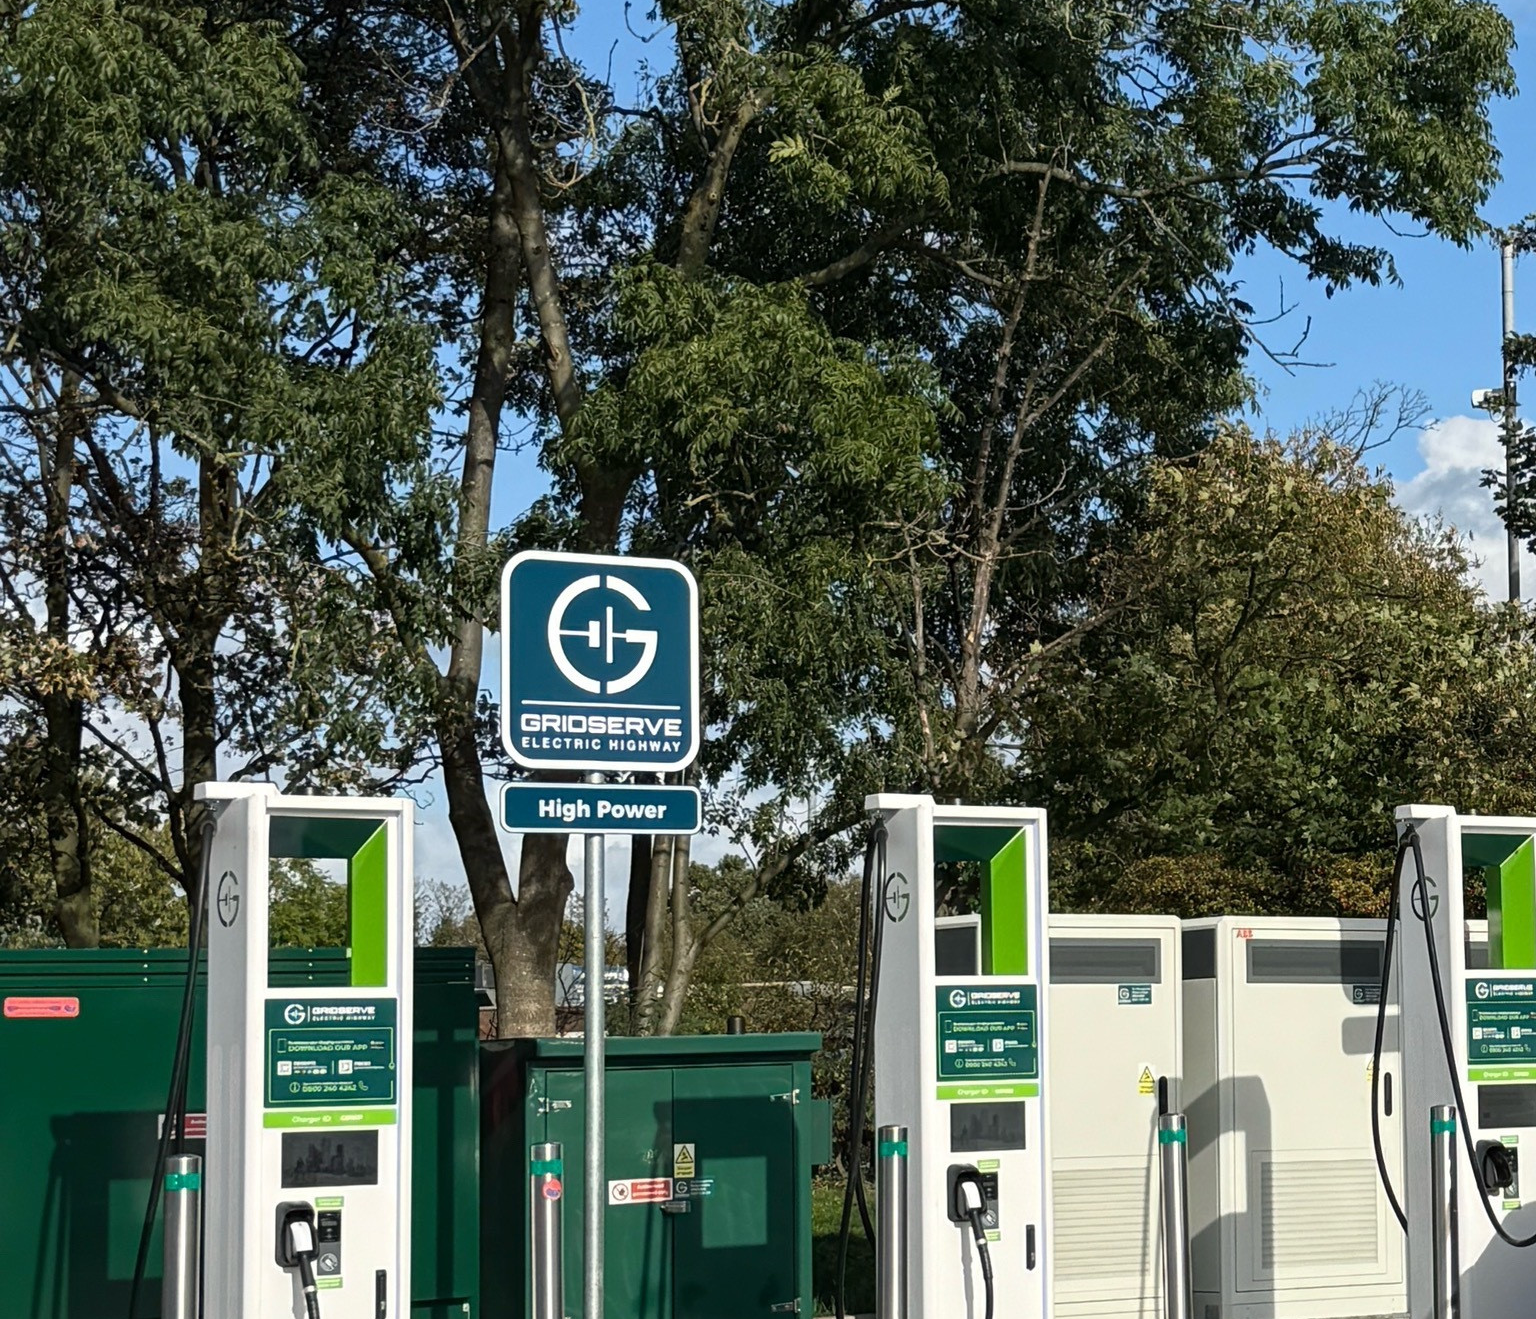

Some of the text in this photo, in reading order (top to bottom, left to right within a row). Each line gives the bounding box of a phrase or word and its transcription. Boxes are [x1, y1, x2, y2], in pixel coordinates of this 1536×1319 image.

[520, 713, 682, 737] GRIDSERVE
[522, 737, 681, 753] ELECTRIC HIGHWAY
[538, 799, 667, 822] High Power
[1236, 929, 1253, 938] ABB
